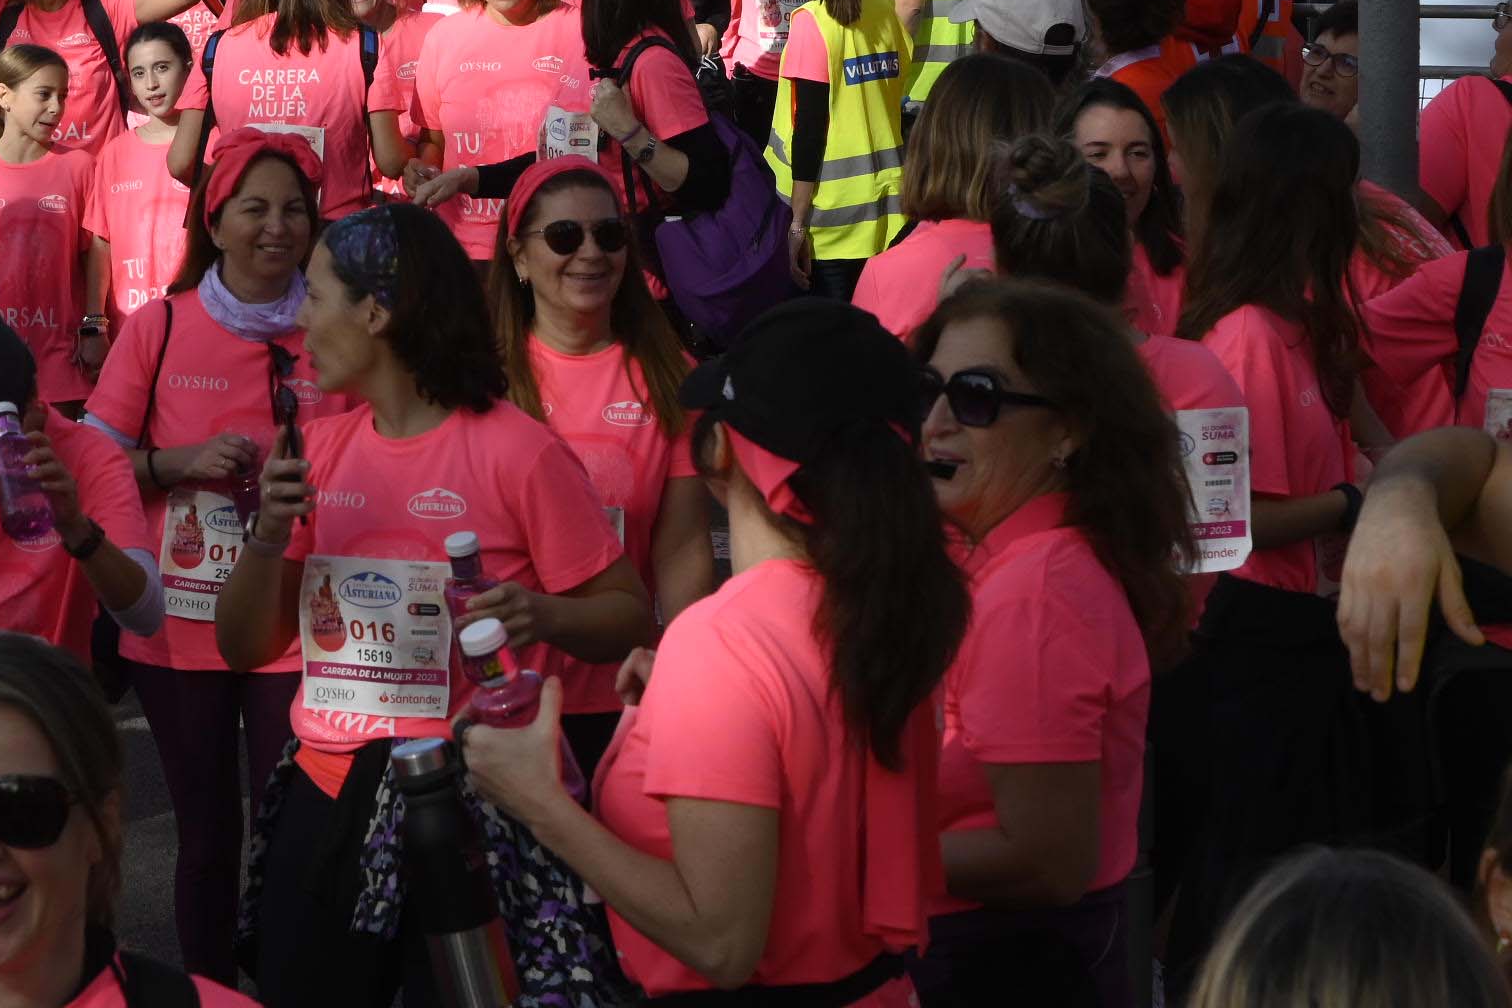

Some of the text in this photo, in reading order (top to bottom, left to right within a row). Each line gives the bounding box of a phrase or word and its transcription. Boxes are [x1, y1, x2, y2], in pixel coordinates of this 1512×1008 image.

[459, 61, 501, 73] OYSHO
[239, 68, 320, 85] CARRERA
[252, 85, 303, 101] DE LA
[248, 100, 307, 118] MUJER
[454, 132, 480, 154] TU
[122, 258, 146, 279] TU
[168, 374, 229, 391] OYSHO
[1202, 430, 1236, 441] SUMA
[1210, 525, 1232, 535] 2023
[208, 543, 237, 563] 01
[174, 579, 211, 591] CARRERA
[343, 584, 397, 601] ASTURIANA
[408, 582, 440, 592] SUMA
[168, 596, 210, 611] OYSHO
[350, 619, 395, 642] 016
[356, 648, 393, 664] 15619
[321, 666, 357, 677] CARRERA
[359, 669, 370, 678] DE
[371, 670, 382, 679] LA
[383, 671, 413, 681] MUJER
[316, 687, 355, 700] OYSHO
[389, 694, 441, 705] Santander
